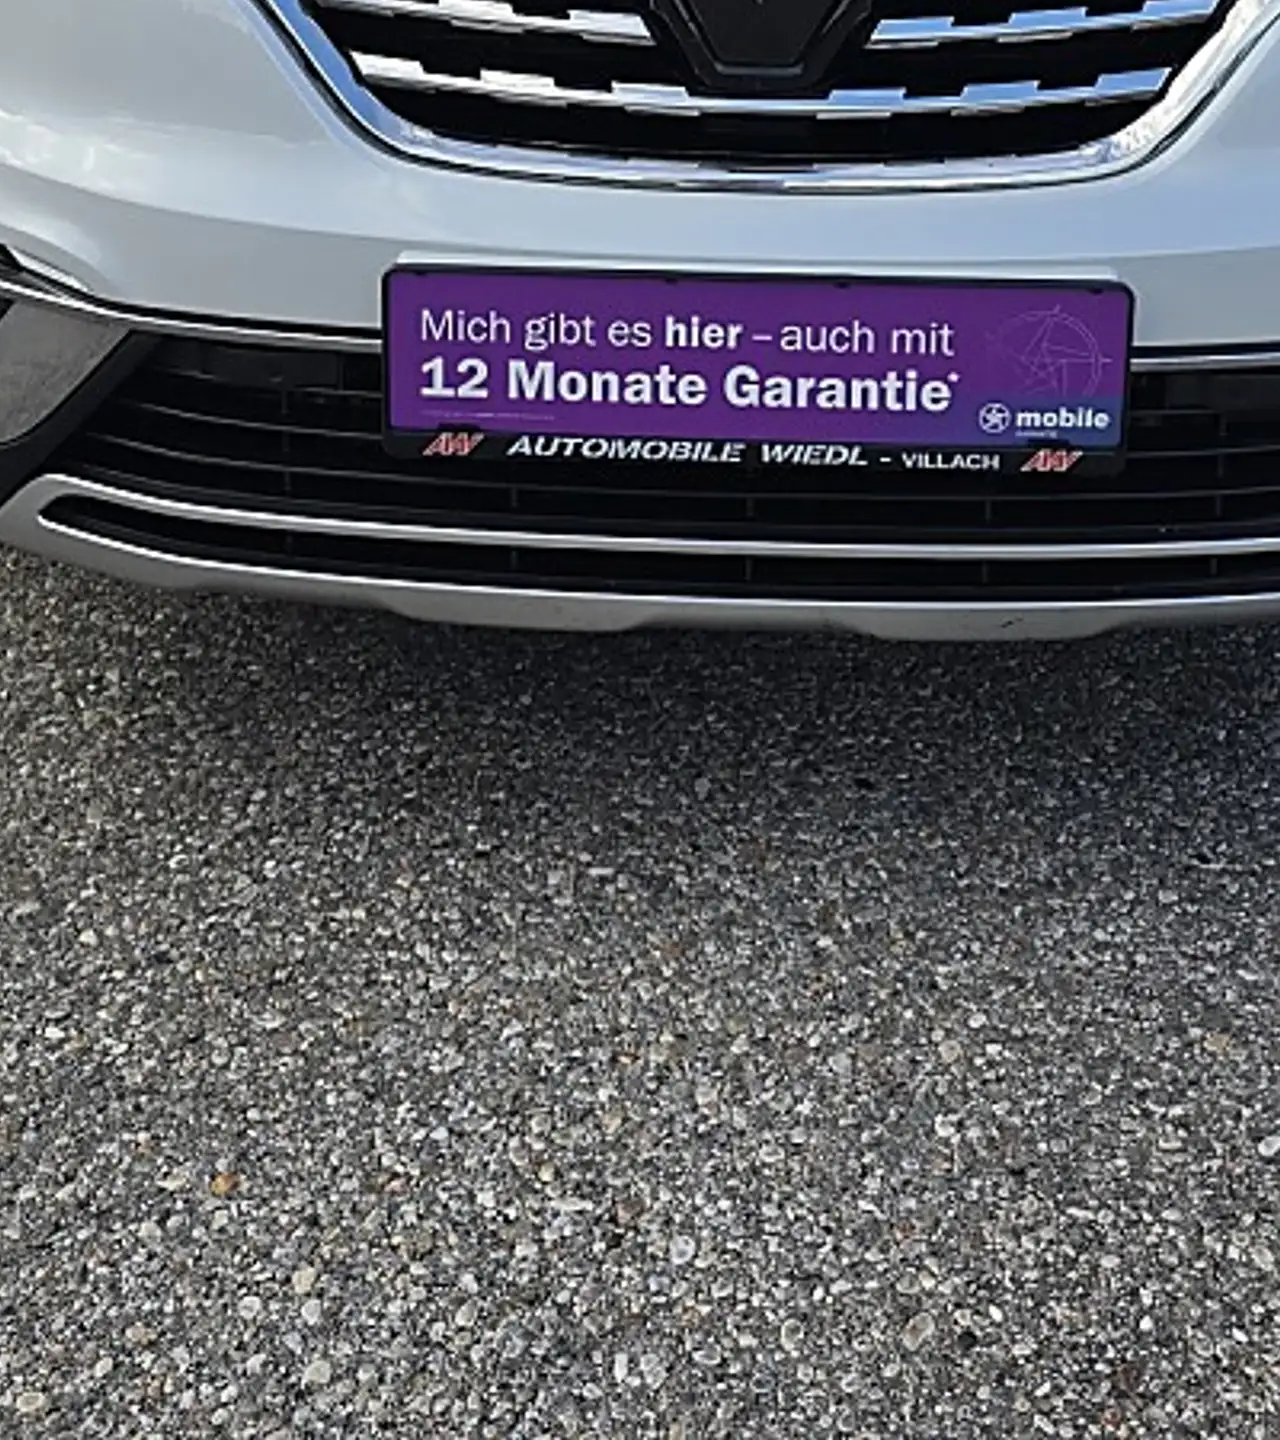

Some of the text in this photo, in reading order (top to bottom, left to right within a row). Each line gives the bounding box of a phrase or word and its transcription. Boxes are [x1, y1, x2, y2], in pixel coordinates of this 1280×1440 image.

[420, 307, 512, 344] Mich
[524, 312, 597, 352] gibt
[607, 319, 653, 347] es
[665, 315, 744, 350] hier
[780, 319, 875, 354] auch
[890, 321, 956, 357] mit
[420, 356, 489, 399] 12
[507, 358, 708, 406] Monate
[1015, 406, 1111, 430] mobile
[505, 434, 747, 463] AUTOMOBILE
[761, 443, 869, 467] WIEDL
[901, 452, 1001, 471] VILLACH
